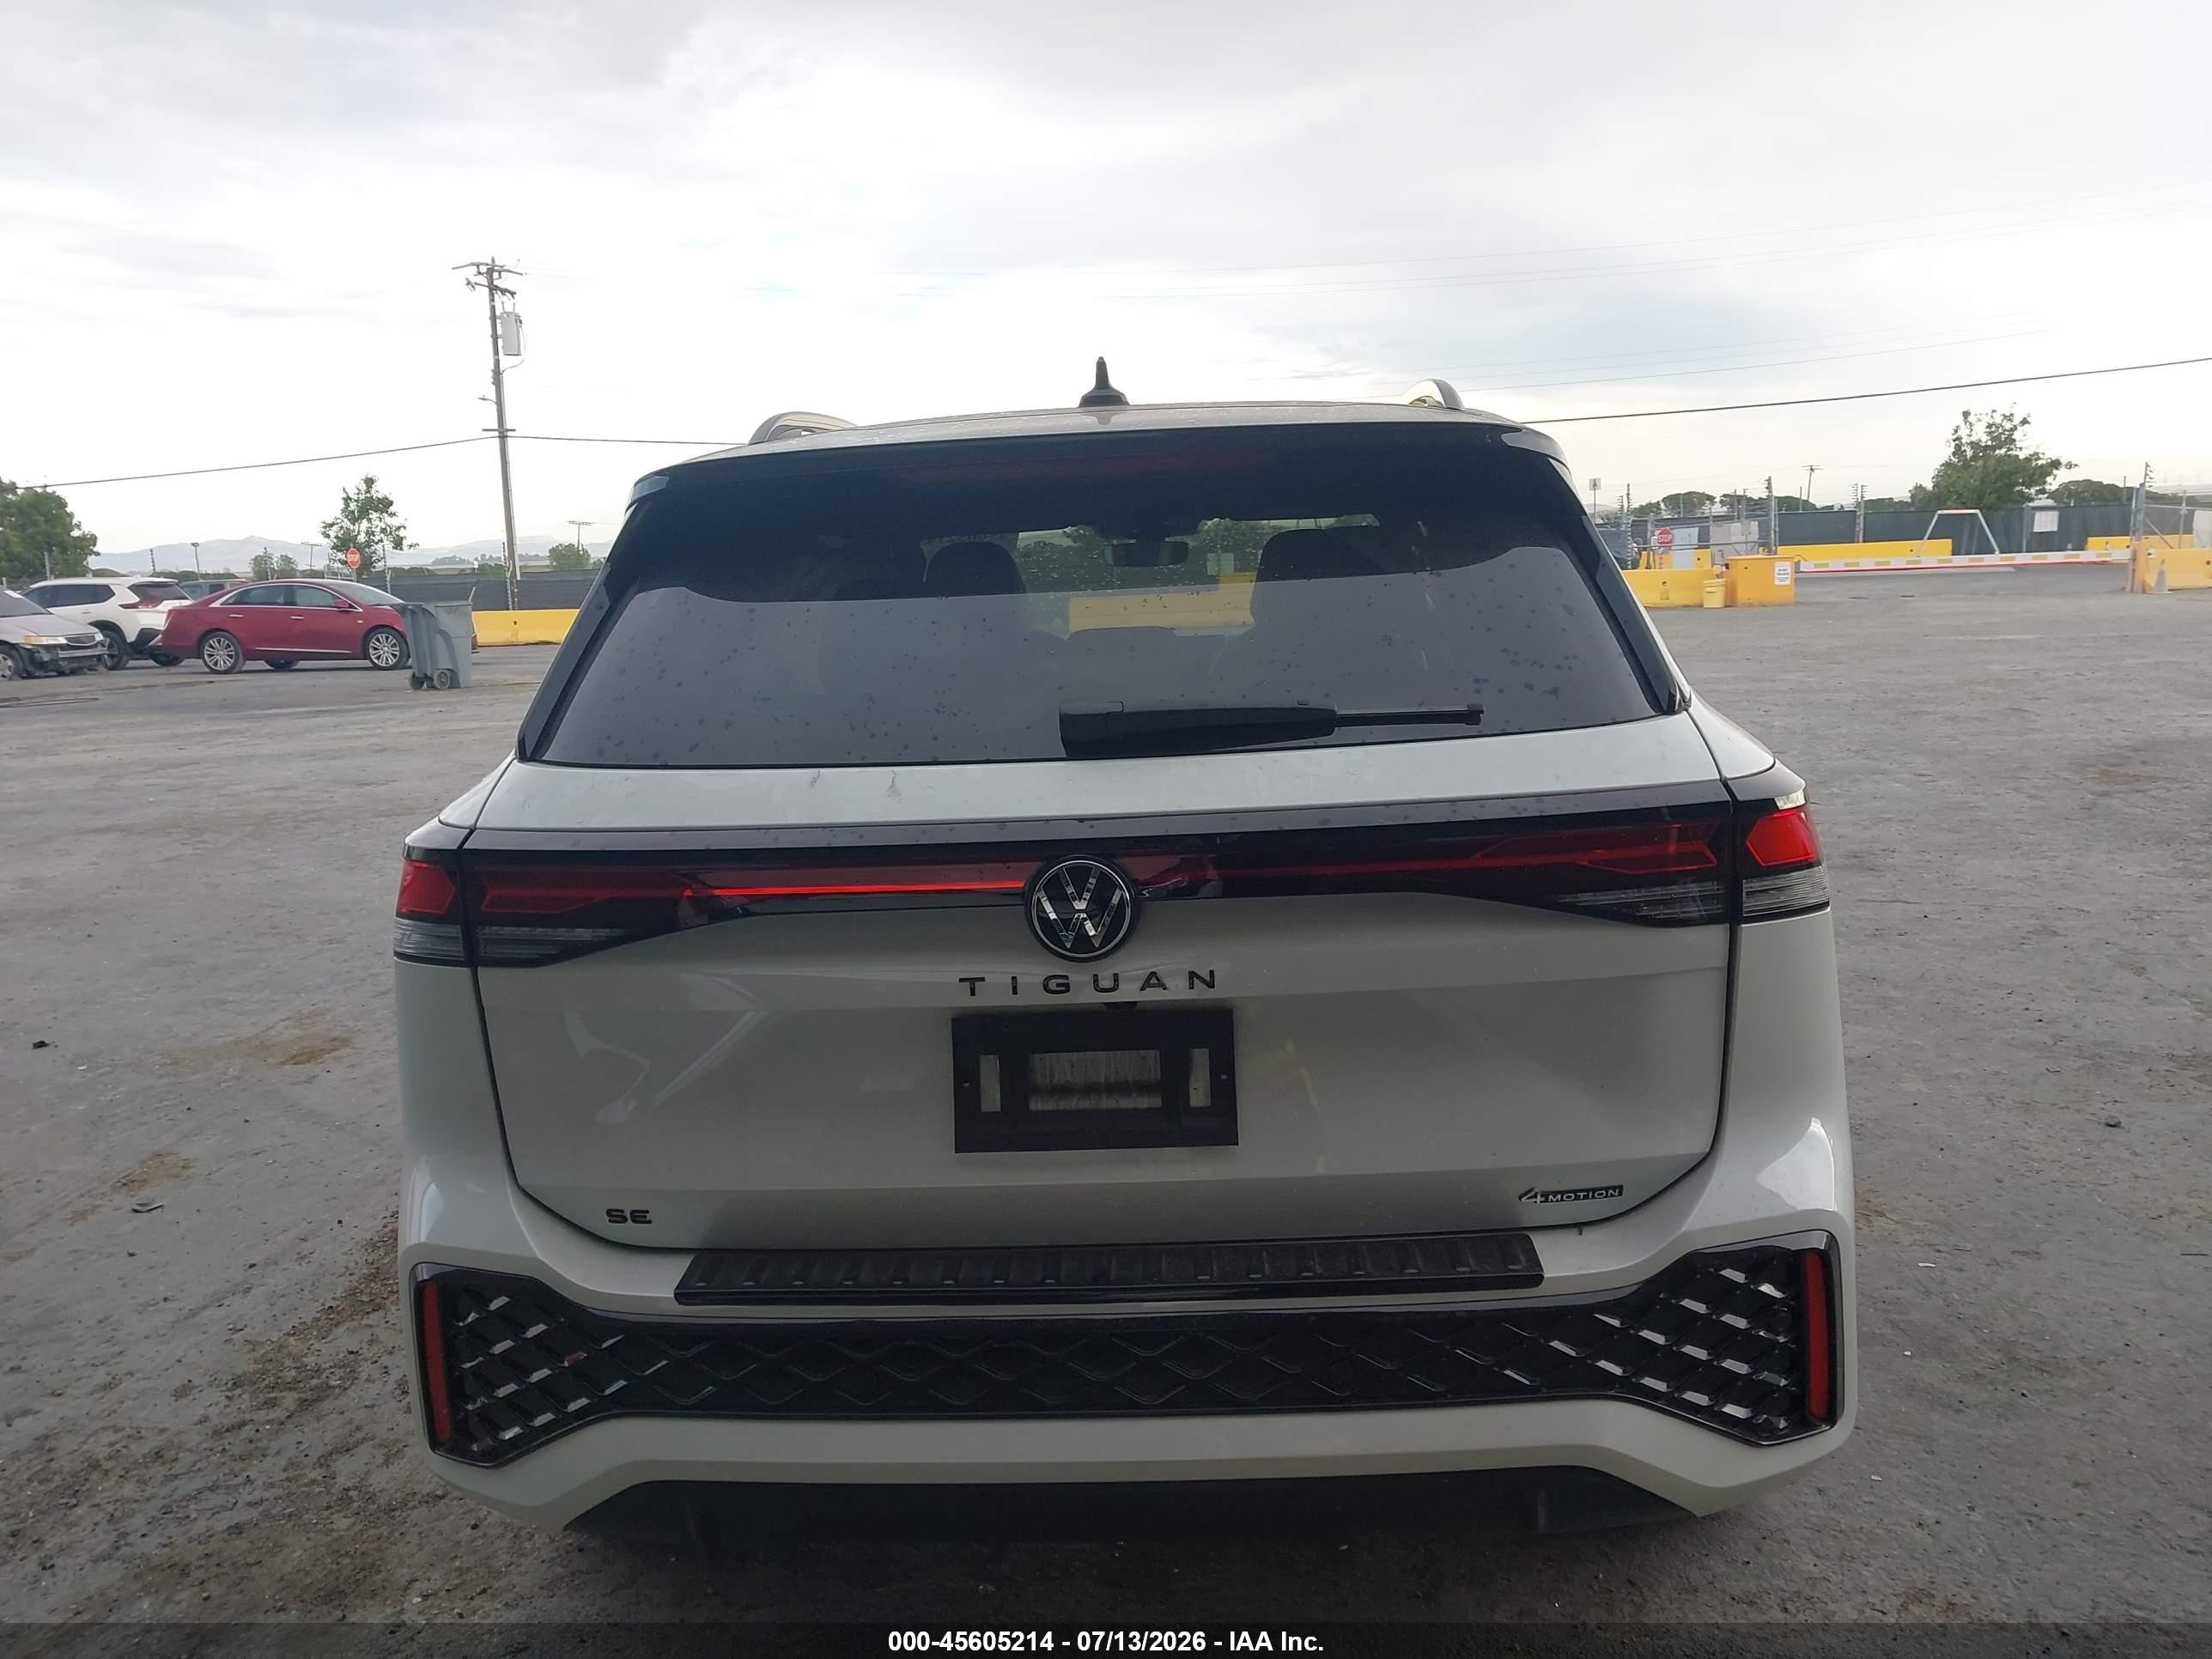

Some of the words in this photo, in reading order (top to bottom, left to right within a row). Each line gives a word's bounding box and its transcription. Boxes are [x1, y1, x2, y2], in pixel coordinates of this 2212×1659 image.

[1657, 534, 1672, 543] STOP
[958, 969, 1216, 996] TIGUAN
[605, 1208, 653, 1224] SE
